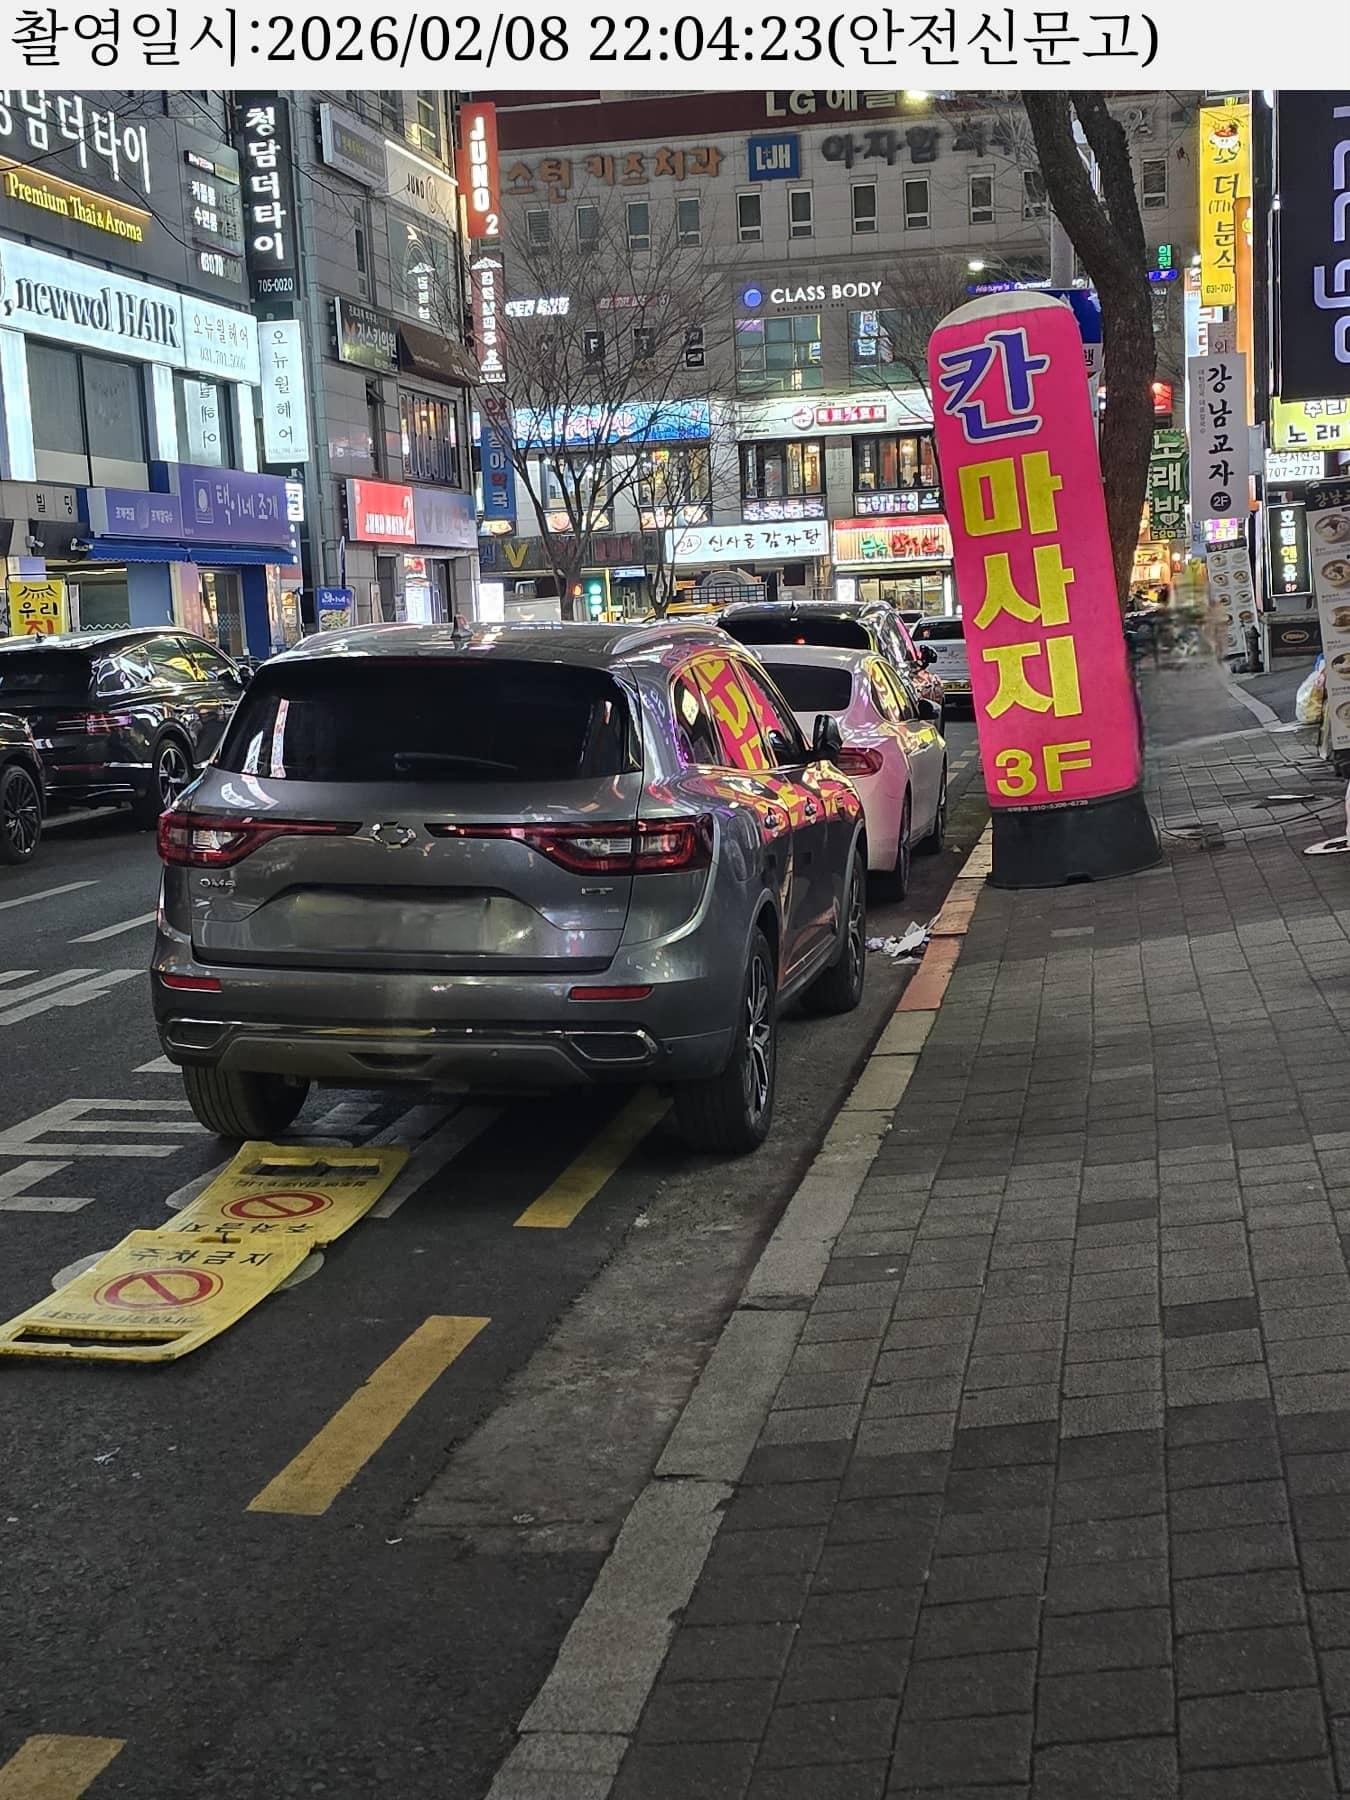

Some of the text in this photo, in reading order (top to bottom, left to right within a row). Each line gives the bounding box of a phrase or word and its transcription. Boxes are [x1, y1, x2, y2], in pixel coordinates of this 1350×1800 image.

[766, 90, 816, 117] LG
[470, 116, 491, 213] JUNO
[6, 171, 69, 216] Premium
[246, 106, 287, 260] 청담더타이
[407, 172, 425, 200] JUNO
[1213, 173, 1240, 199] 더
[258, 279, 293, 293] 705-0020
[770, 281, 882, 304] CLASS BODY
[117, 291, 181, 348] HAIR
[1207, 363, 1235, 487] 강남교자
[1150, 433, 1185, 513] 노래방
[1268, 465, 1321, 478] 707-2771
[1213, 495, 1229, 507] 2F
[940, 327, 1050, 444] 칸
[995, 740, 1092, 797] 3F
[18, 601, 59, 619] 우리
[129, 1247, 275, 1266] 주차금지
